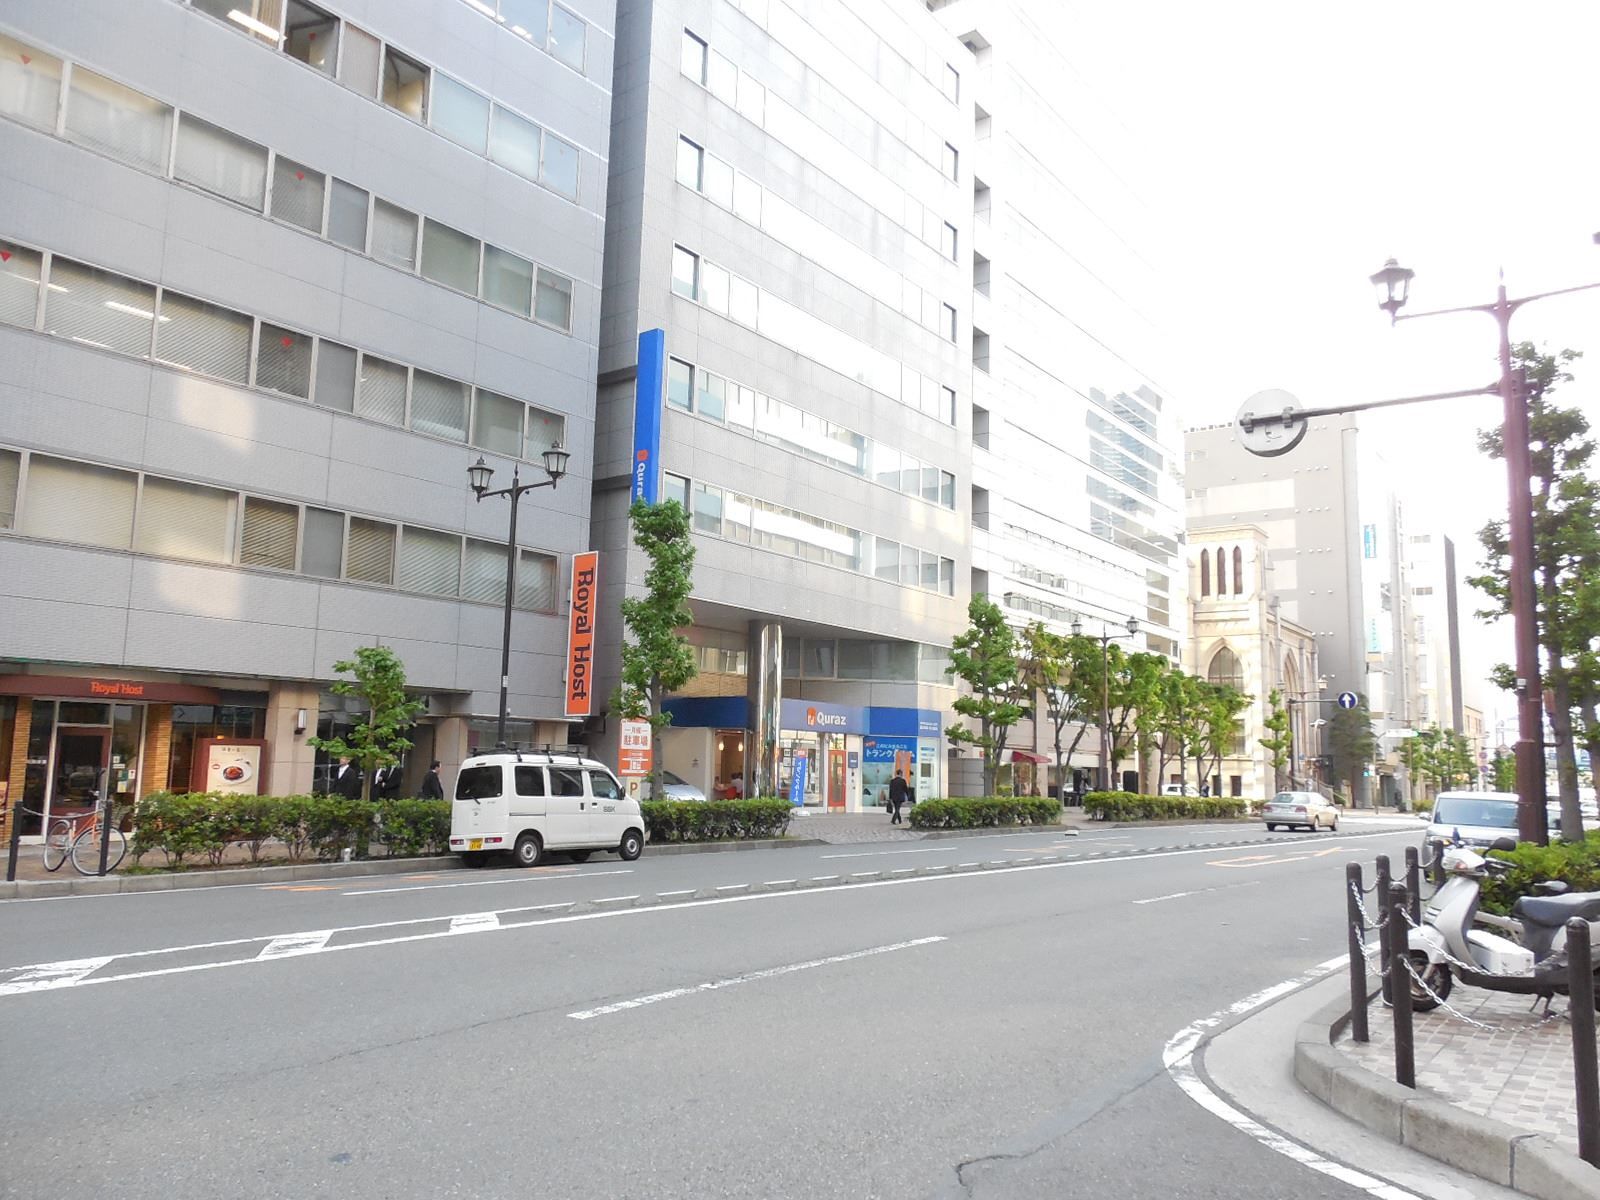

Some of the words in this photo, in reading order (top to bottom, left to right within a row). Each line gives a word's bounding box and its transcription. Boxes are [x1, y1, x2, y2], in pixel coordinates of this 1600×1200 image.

[636, 462, 646, 498] Qura
[573, 567, 594, 635] Royal
[572, 643, 591, 700] Host
[91, 681, 120, 695] Royal
[121, 683, 144, 695] Host
[817, 711, 847, 726] Quraz
[629, 781, 639, 796] P
